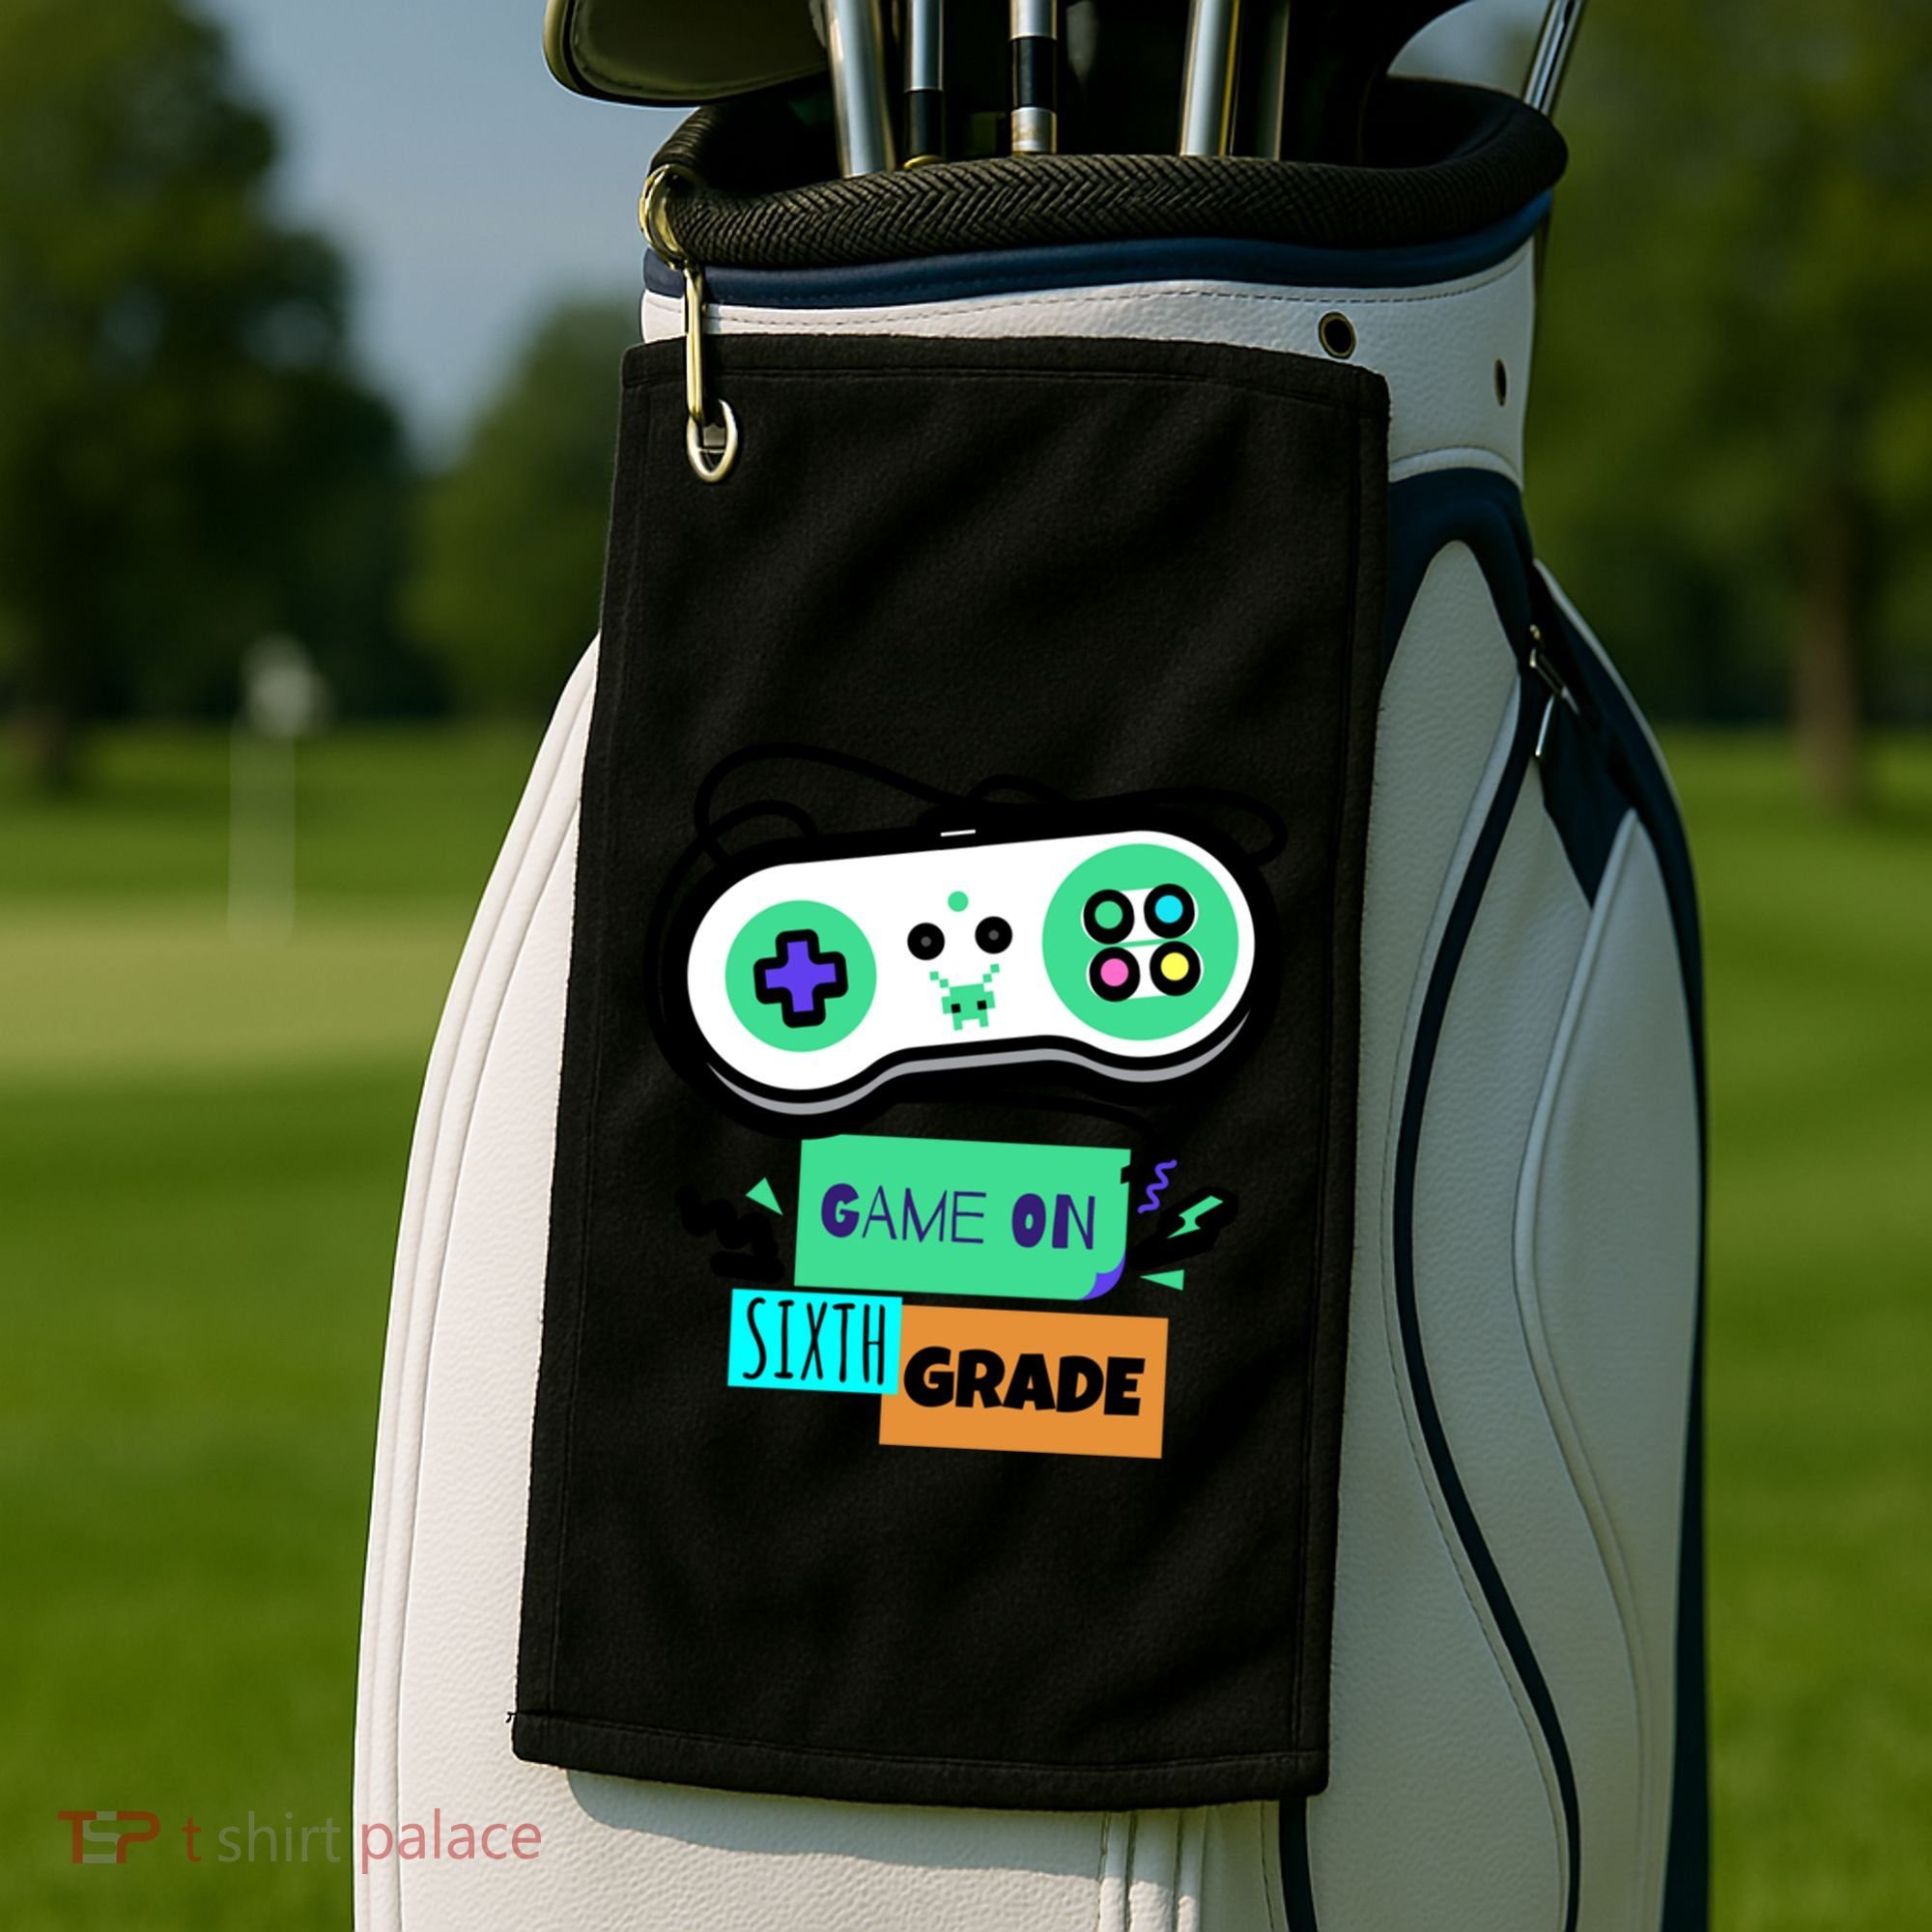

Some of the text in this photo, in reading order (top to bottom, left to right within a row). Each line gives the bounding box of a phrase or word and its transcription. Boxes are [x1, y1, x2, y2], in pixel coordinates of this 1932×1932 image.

[820, 1182, 1096, 1250] GAME ON
[742, 1296, 886, 1385] SIXTH
[903, 1346, 1146, 1416] GRADE
